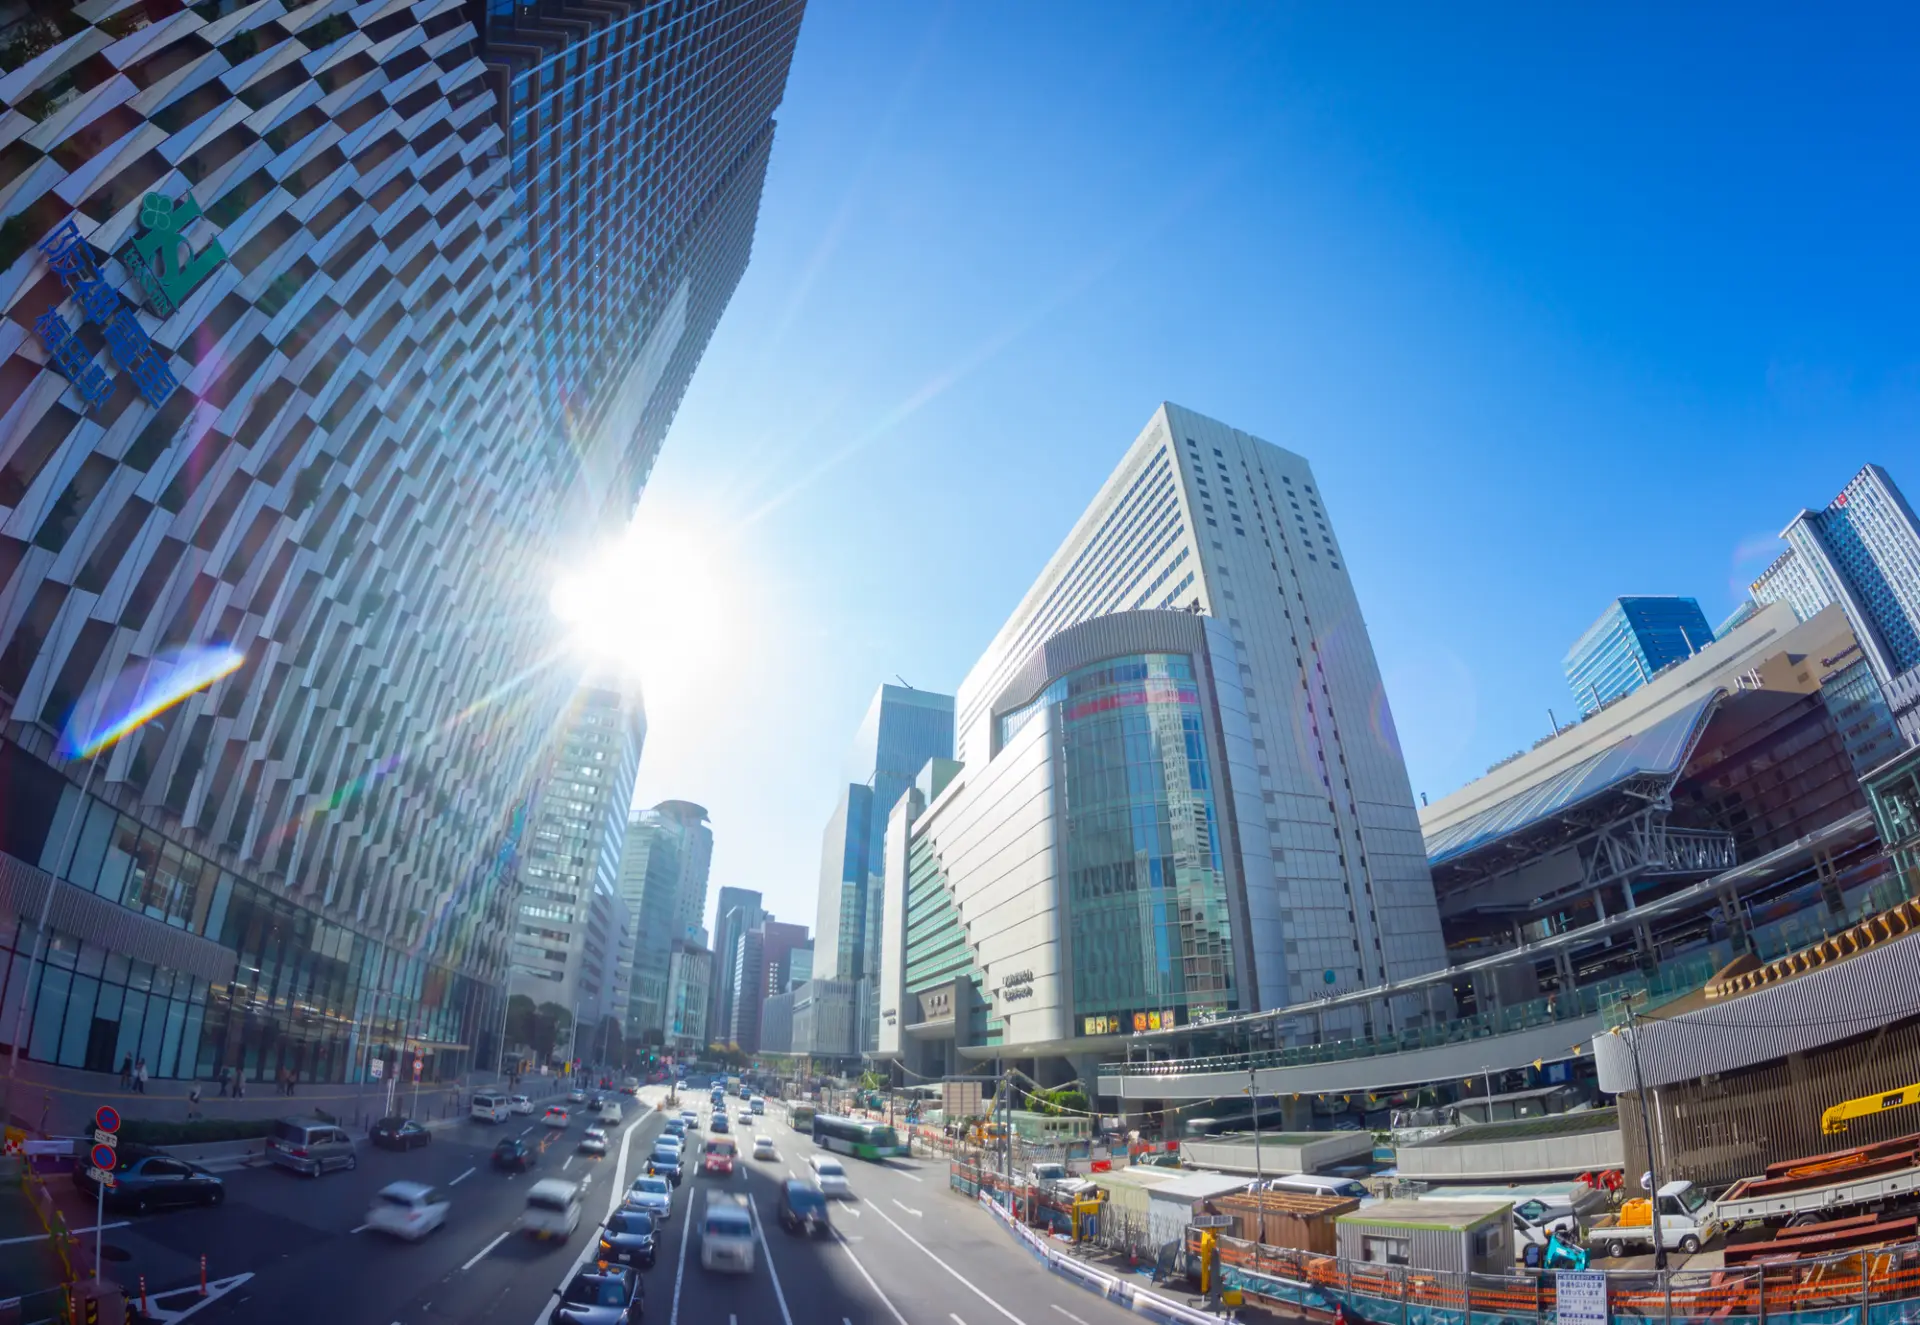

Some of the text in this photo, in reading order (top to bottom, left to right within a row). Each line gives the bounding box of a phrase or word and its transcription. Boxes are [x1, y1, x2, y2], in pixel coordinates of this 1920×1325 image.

[39, 218, 179, 410] 阪神電車
[122, 246, 172, 318] HANSHIN
[32, 303, 118, 411] 梅田駅
